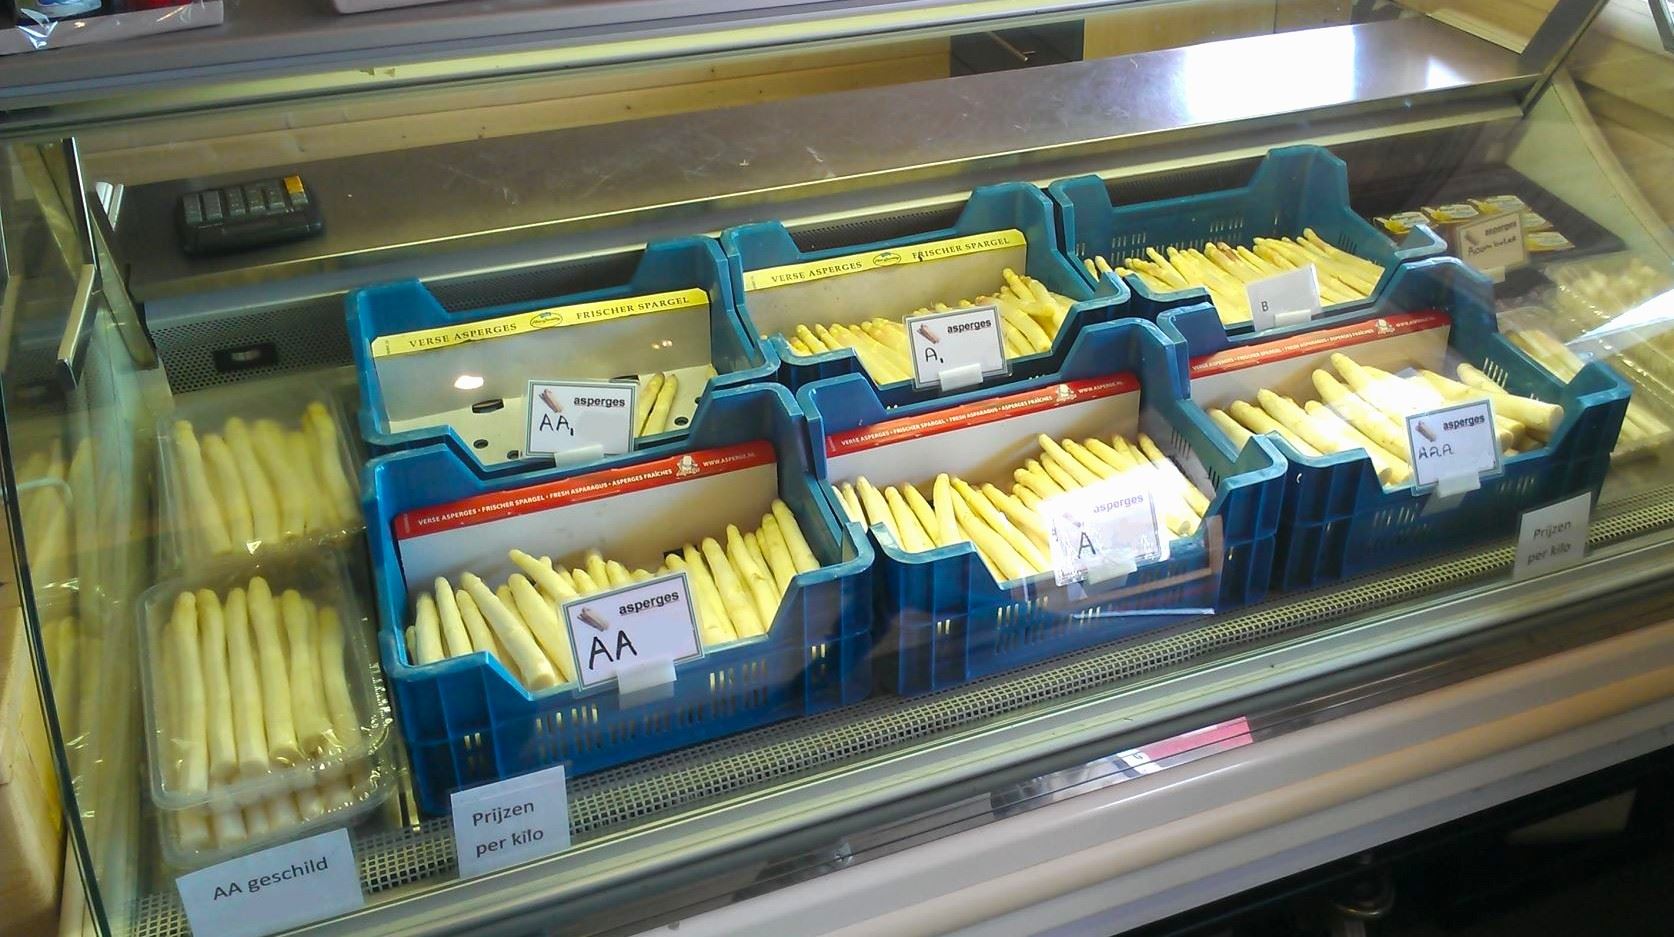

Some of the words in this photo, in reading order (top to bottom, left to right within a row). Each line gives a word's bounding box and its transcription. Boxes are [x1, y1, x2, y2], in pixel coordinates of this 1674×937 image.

[912, 244, 962, 259] FRISCHER
[965, 237, 1009, 250] SPARGEL
[771, 271, 806, 283] VERSE
[808, 261, 863, 277] ASPERGES
[576, 304, 634, 320] FRISCHER
[638, 296, 689, 311] SPARGEL
[1261, 301, 1269, 312] B
[409, 334, 450, 348] VERSE
[454, 322, 517, 341] ASPERGES
[947, 319, 991, 334] asperges
[573, 397, 626, 408] asperges
[1443, 414, 1485, 431] asperges
[418, 516, 440, 526] VERSE
[441, 509, 477, 521] ASPERGES
[481, 501, 514, 513] FRISCHER
[515, 495, 545, 506] SPARGEL
[549, 490, 570, 499] FRESH
[570, 482, 608, 495] ASPARAGUS
[612, 475, 643, 487] ASPERGES
[1093, 494, 1144, 513] asperges
[1533, 521, 1571, 538] Prijzen
[1077, 532, 1096, 559] A
[1528, 550, 1546, 566] per
[1550, 542, 1571, 556] kilo
[619, 591, 679, 614] asperges
[589, 630, 637, 670] AA
[472, 802, 534, 826] Prijzen
[476, 837, 507, 857] per
[511, 829, 544, 846] kilo
[213, 882, 242, 900] AA
[248, 856, 328, 893] geschild
